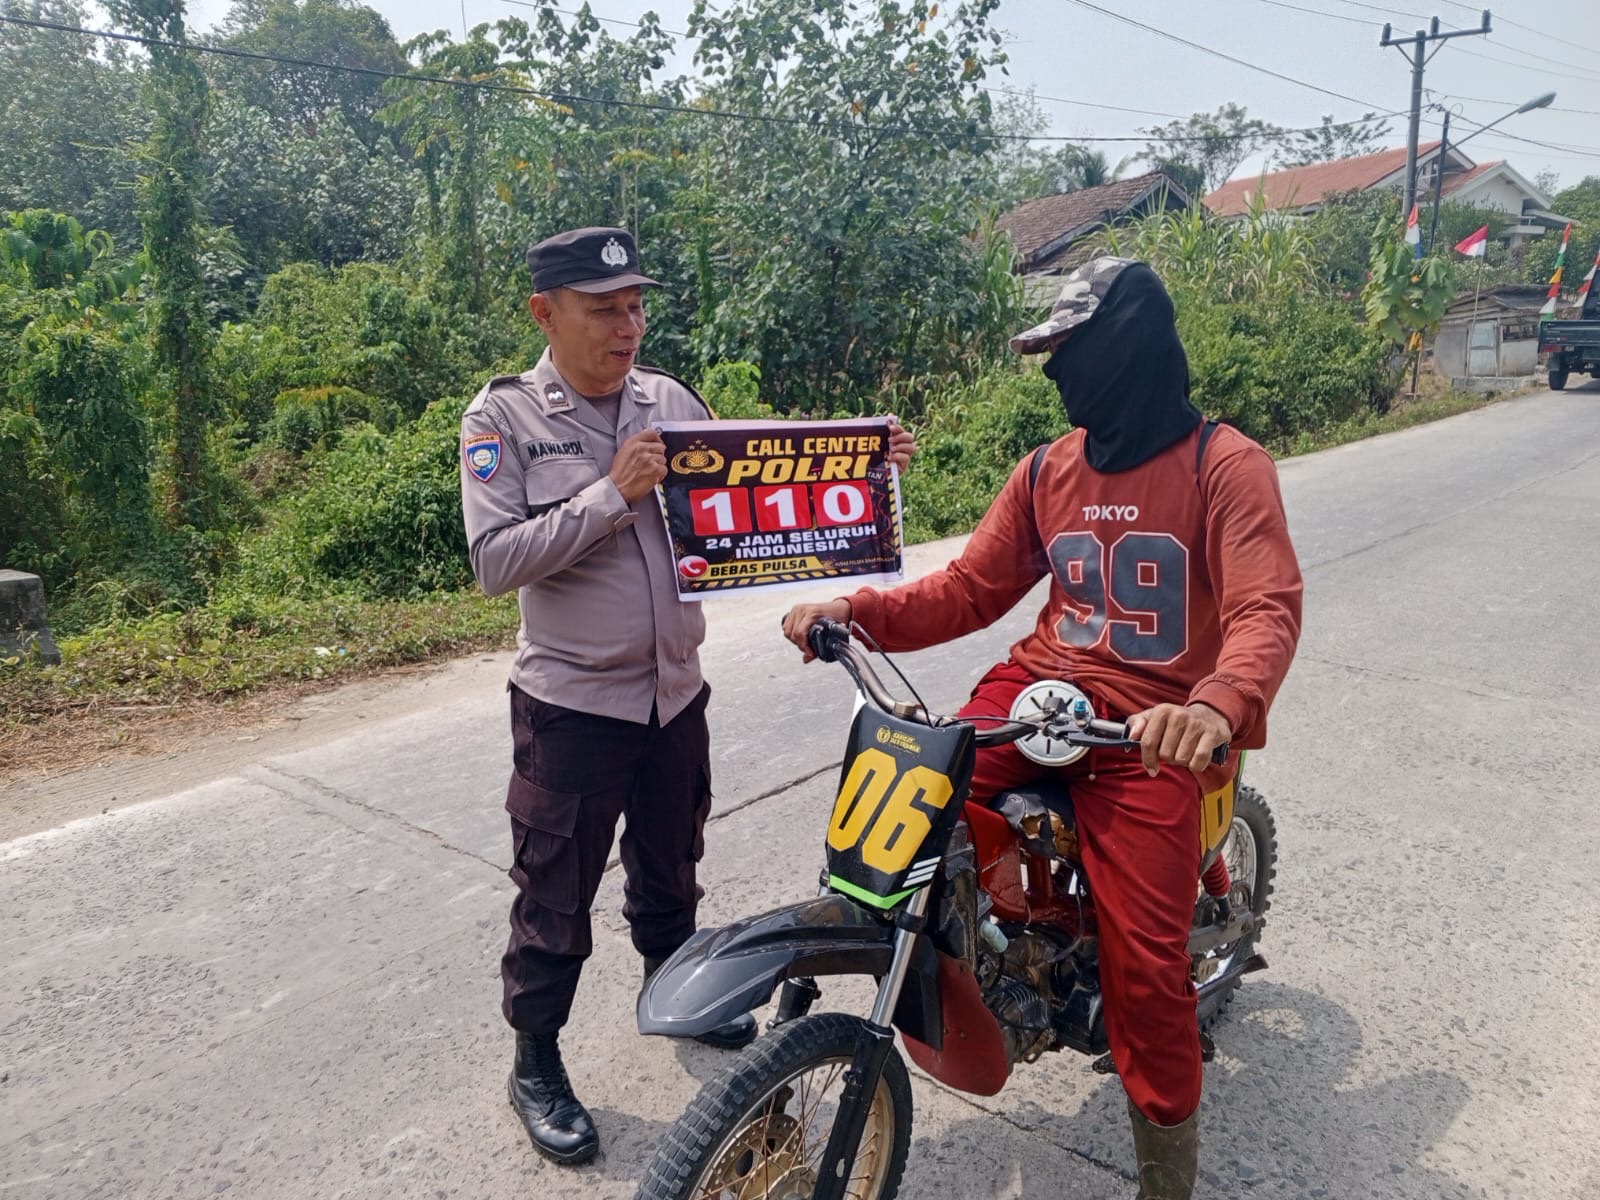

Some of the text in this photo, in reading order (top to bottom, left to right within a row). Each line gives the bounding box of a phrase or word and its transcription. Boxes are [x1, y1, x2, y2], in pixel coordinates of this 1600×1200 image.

[527, 441, 584, 460] MAWARDI
[746, 436, 881, 457] CALL CENTER
[726, 454, 871, 486] POLRI
[1082, 505, 1139, 522] TOKYO
[705, 525, 877, 550] 24 JAM SELURUH
[735, 539, 850, 559] INDONESIA
[710, 559, 808, 577] BEBAS PULSA
[1046, 530, 1190, 665] 99
[827, 747, 954, 875] 06
